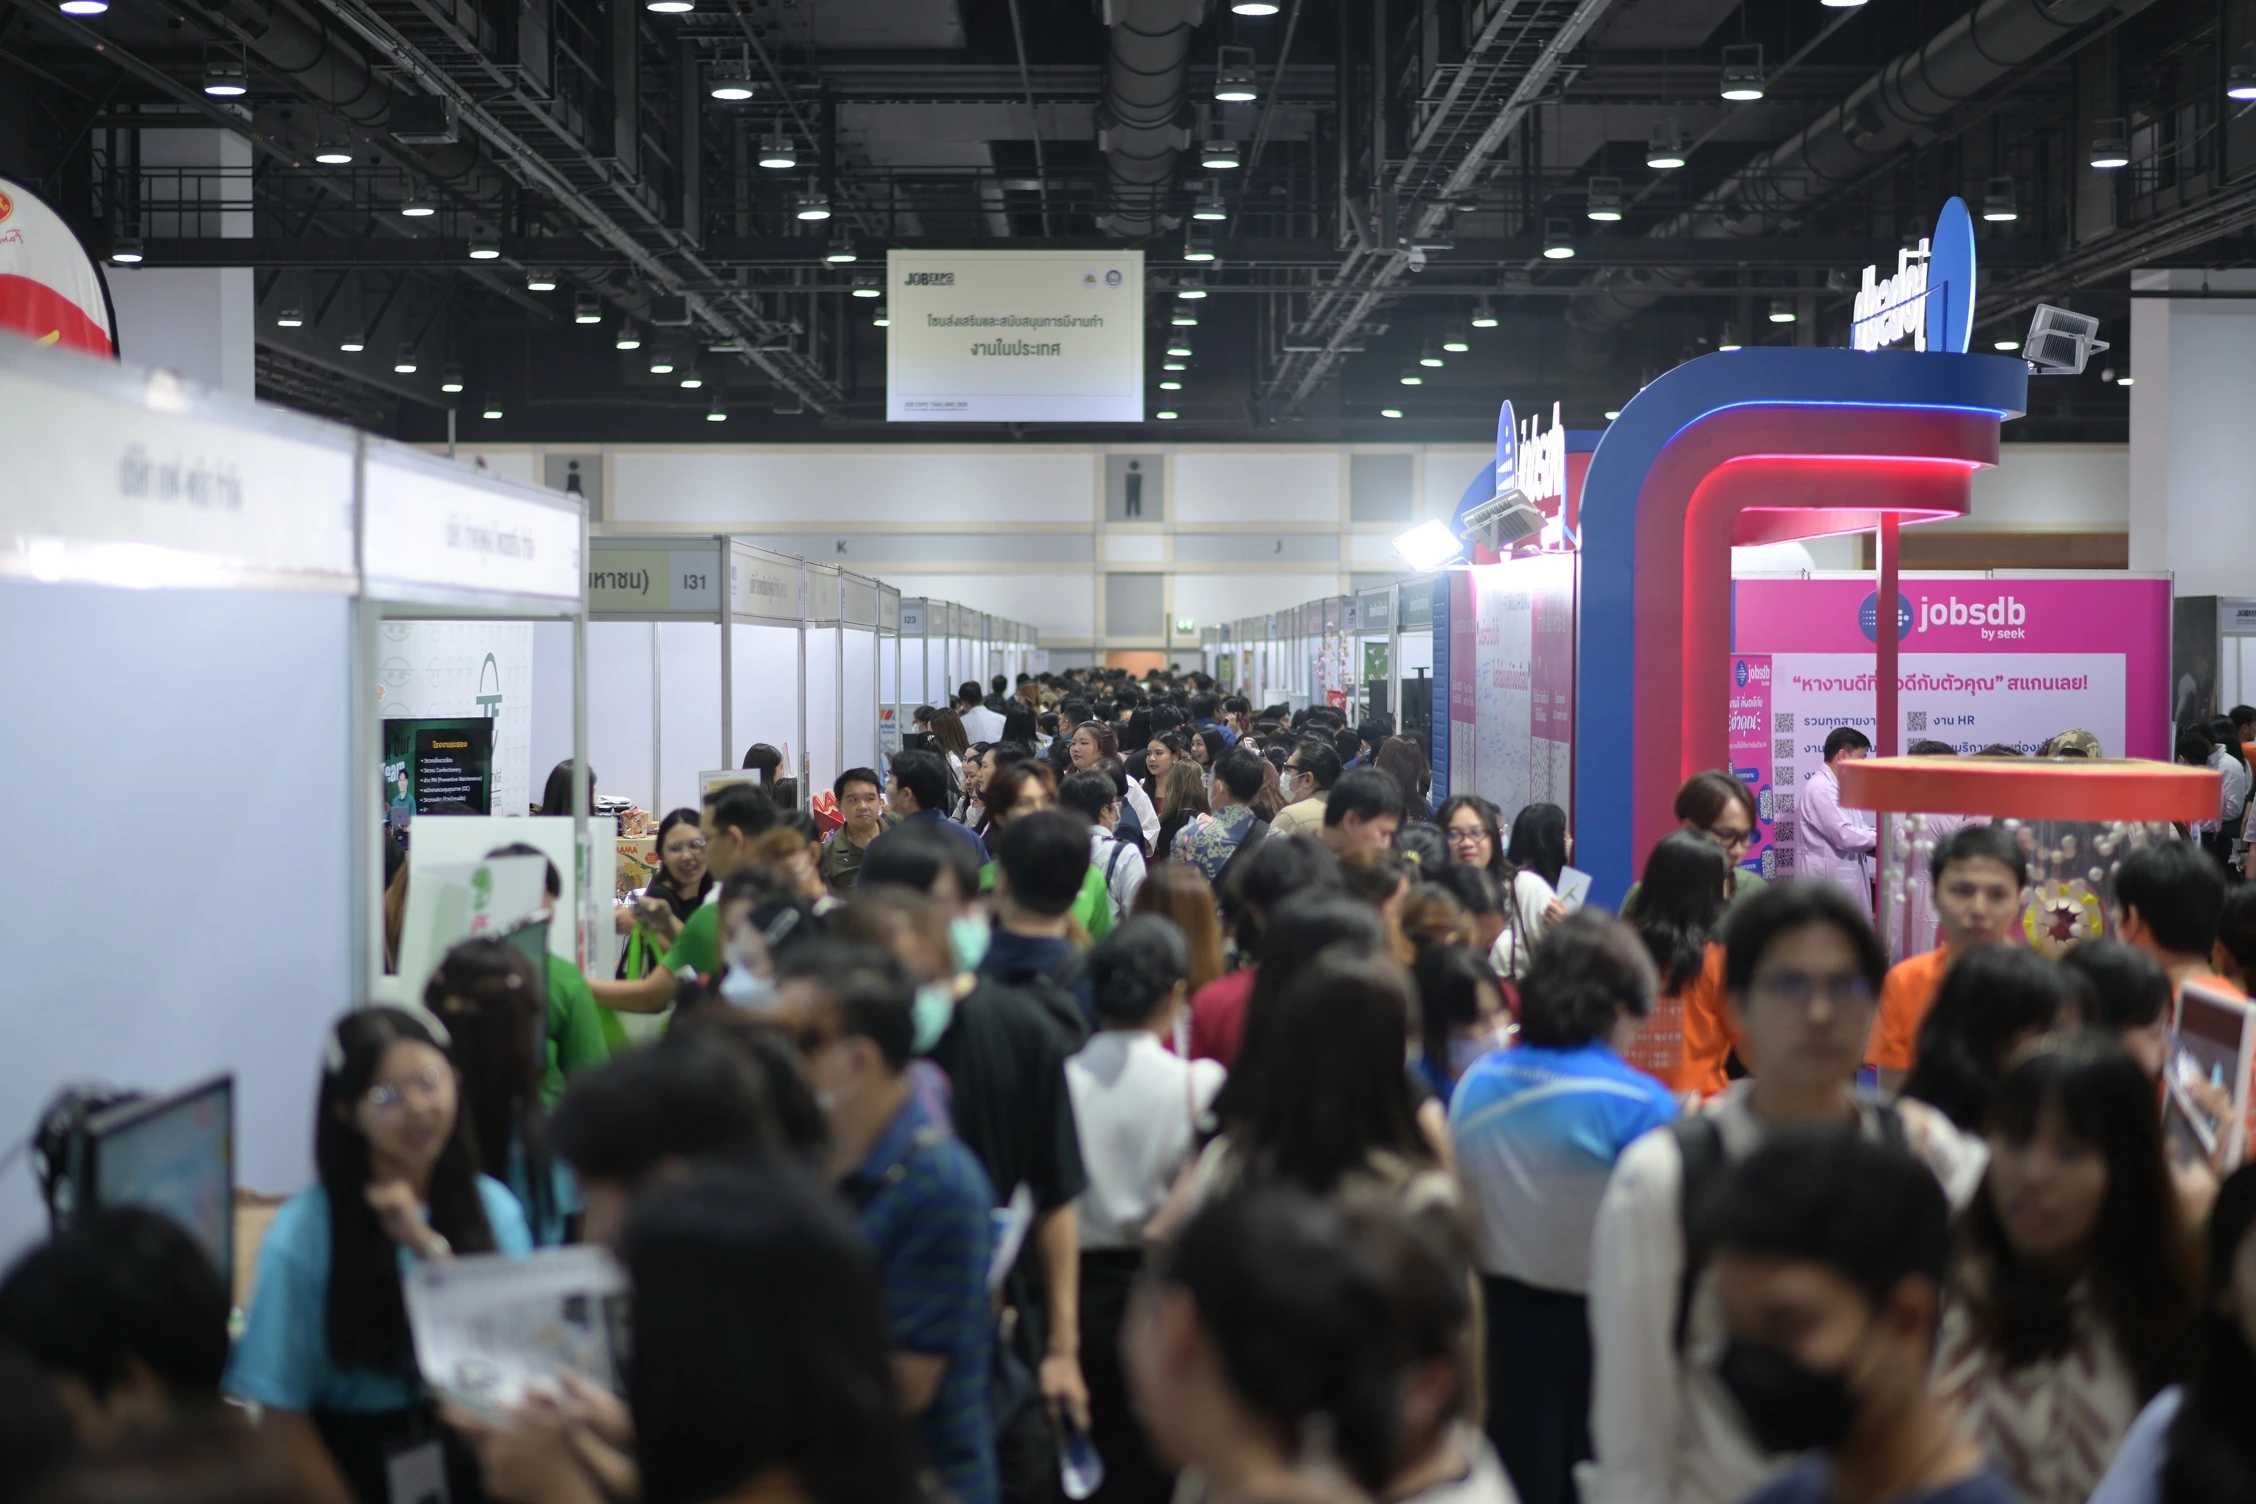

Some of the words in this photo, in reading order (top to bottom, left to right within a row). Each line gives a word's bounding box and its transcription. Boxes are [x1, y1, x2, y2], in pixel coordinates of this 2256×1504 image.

[970, 338, 1060, 356] งานในประเทศ
[836, 541, 847, 554] K
[1918, 596, 2026, 632] jobsdb
[1981, 628, 1995, 641] by
[1998, 627, 2026, 640] seek
[1748, 664, 1770, 684] jobsdb
[1793, 671, 2004, 697] “หางานดีที่อดีกับตัวคุณ”
[2007, 674, 2088, 692] สแกนเลย!
[1803, 717, 1876, 730] รวมทุกสายงา
[1933, 717, 1955, 726] งาน
[1957, 716, 1975, 726] HR
